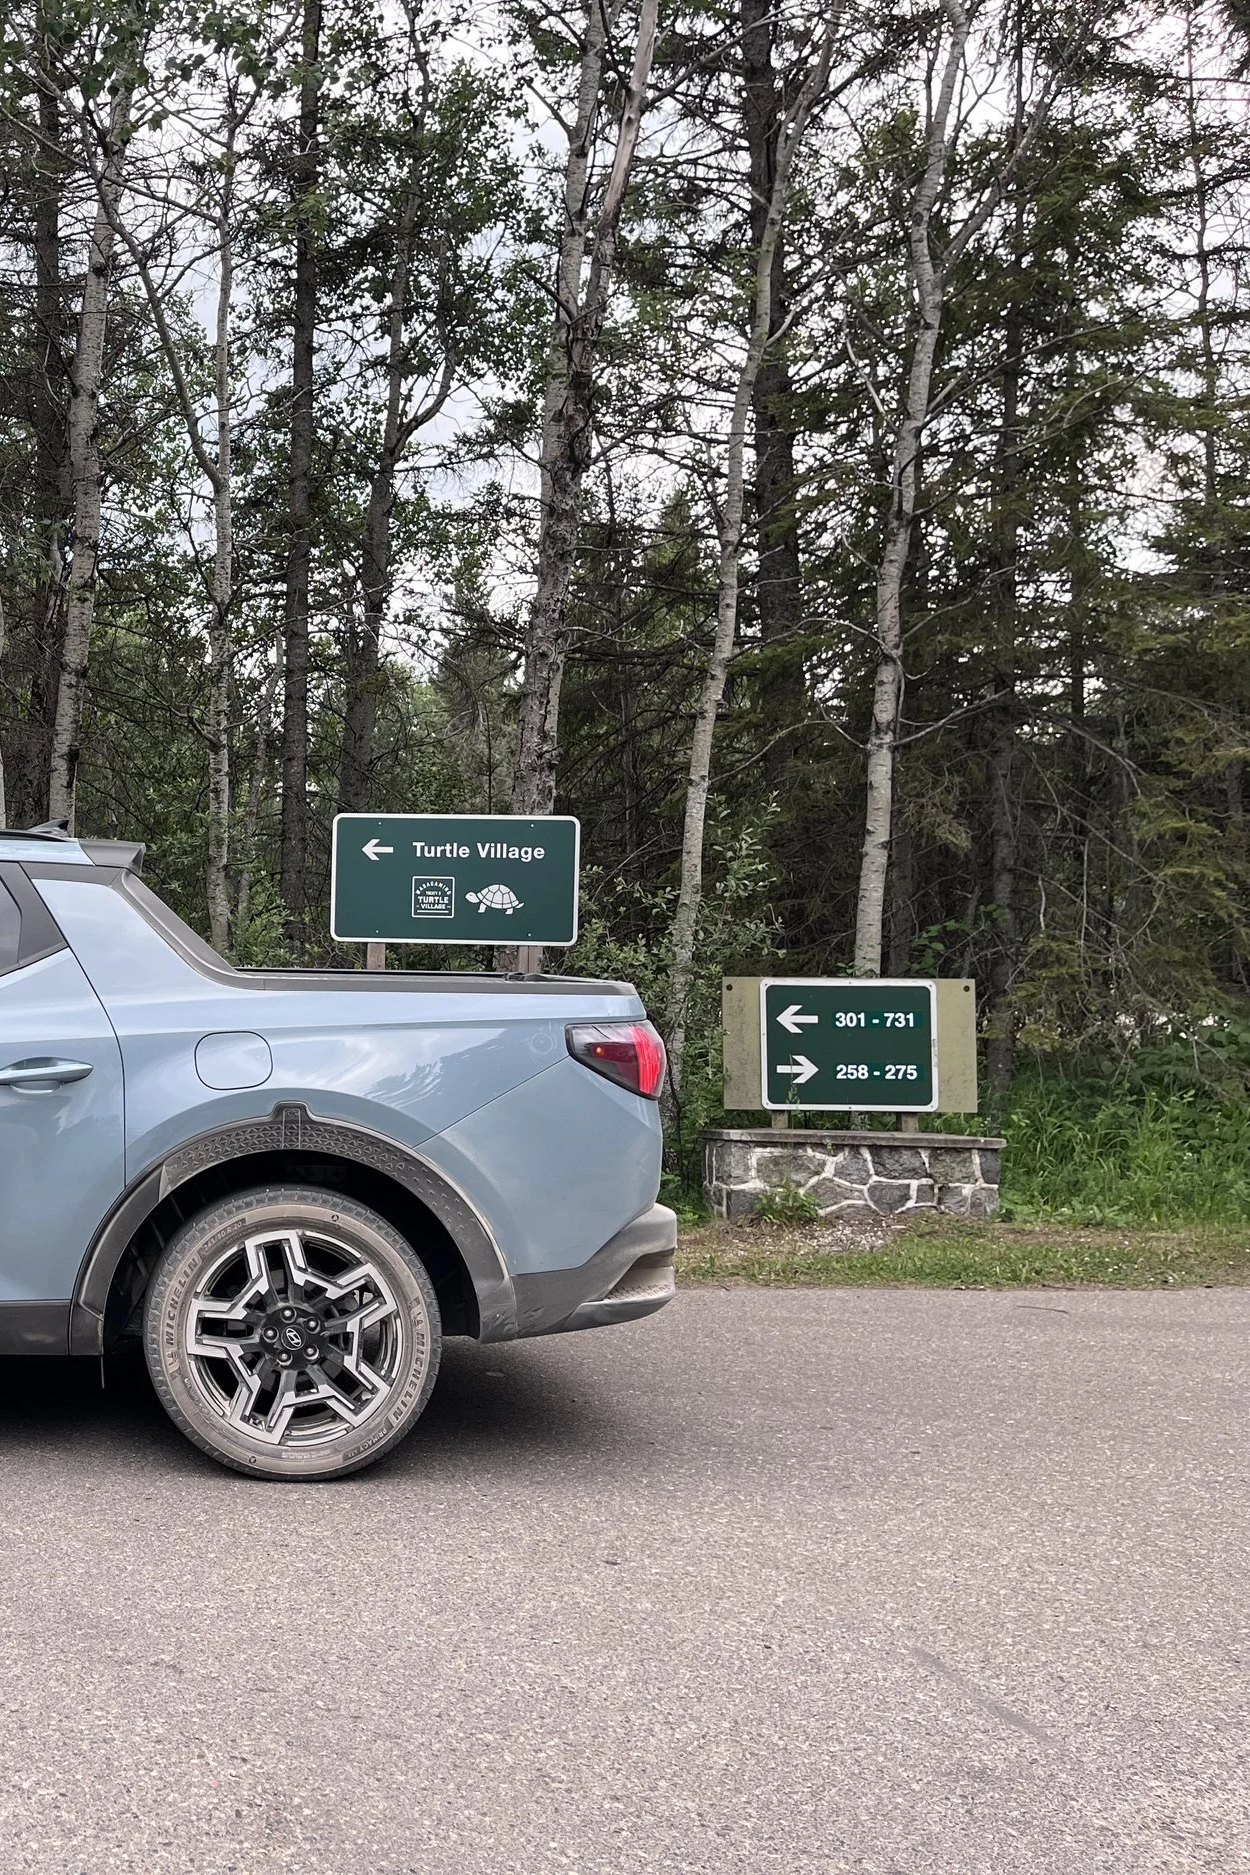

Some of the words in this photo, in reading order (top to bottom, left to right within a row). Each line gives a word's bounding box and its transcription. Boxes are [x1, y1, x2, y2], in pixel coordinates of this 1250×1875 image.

[412, 841, 470, 859] Turtle
[476, 842, 546, 863] Village
[417, 896, 449, 904] TURTLE
[835, 1012, 865, 1028] 301
[883, 1012, 914, 1028] 731
[836, 1064, 869, 1080] 258
[884, 1064, 918, 1080] 275
[165, 1257, 199, 1346] MICHELIN
[392, 1331, 426, 1422] MICHELIN
[358, 1427, 388, 1453] PRIMACY
